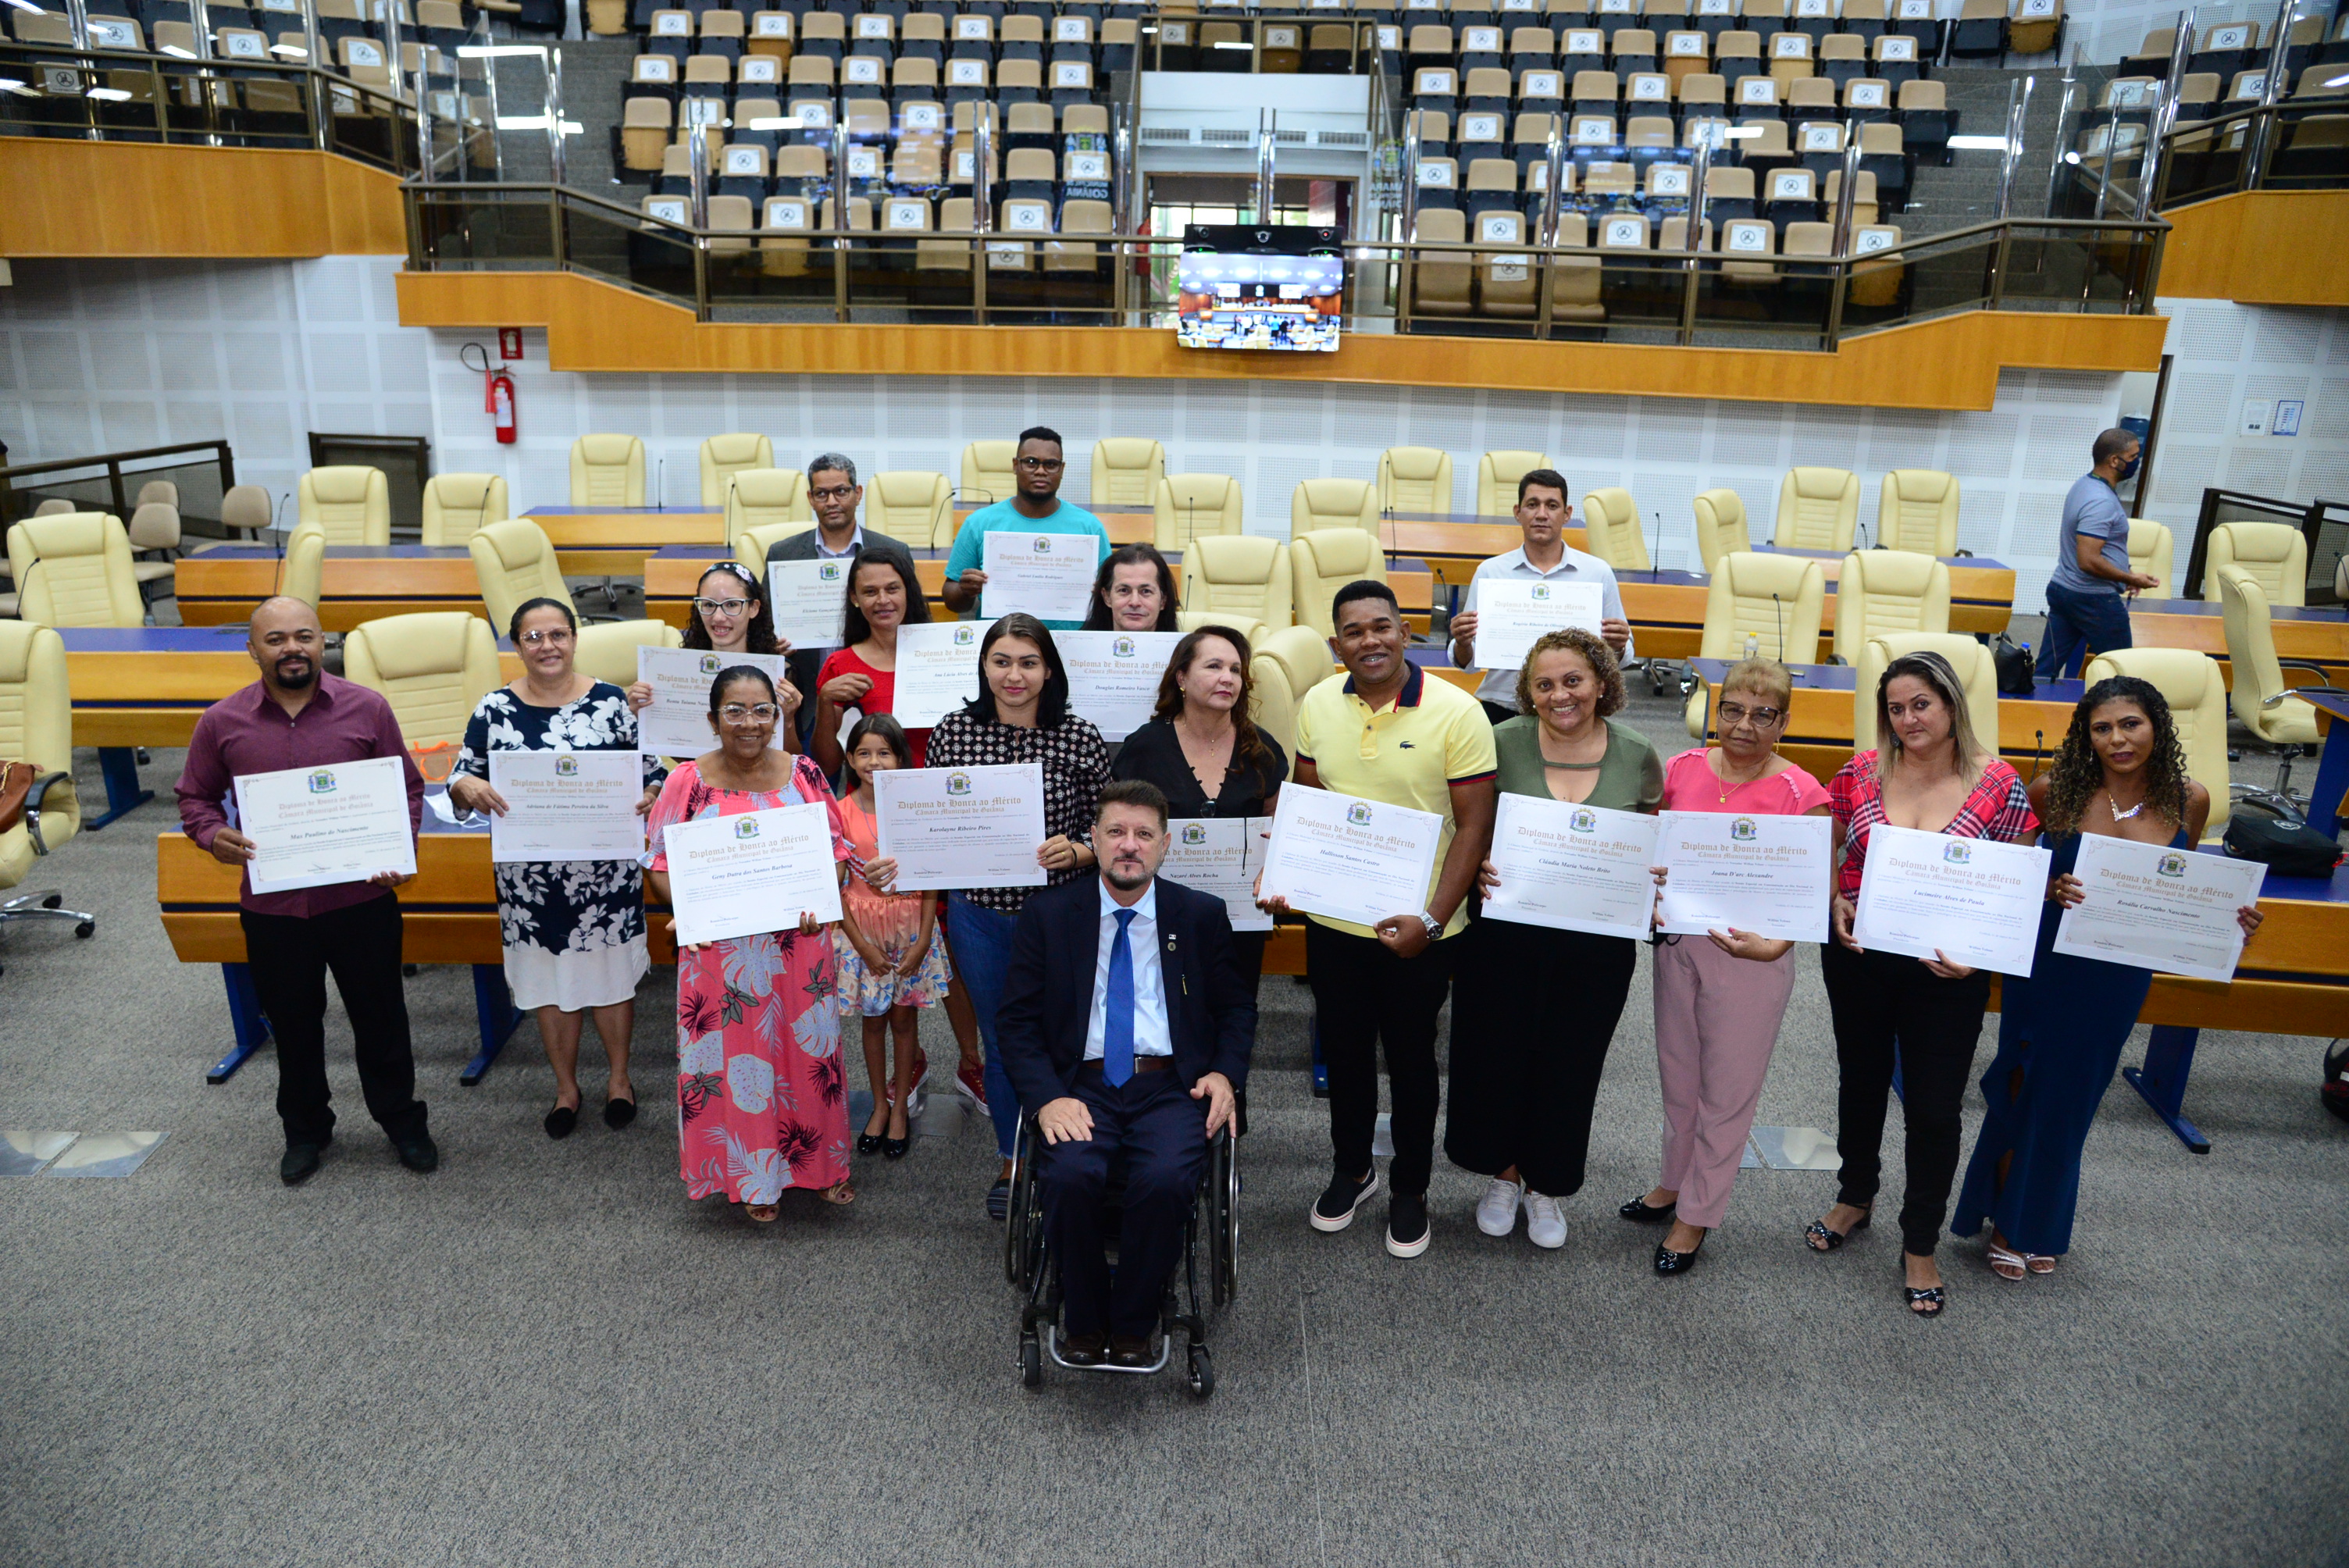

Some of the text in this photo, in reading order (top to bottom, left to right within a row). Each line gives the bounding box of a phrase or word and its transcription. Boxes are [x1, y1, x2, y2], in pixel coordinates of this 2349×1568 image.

[1114, 660, 1138, 668] Honra
[992, 796, 1021, 805] Mérito
[1297, 816, 1331, 830] Diploma
[1334, 824, 1342, 832] de
[1346, 826, 1372, 839] Honra
[1386, 836, 1415, 848] Mérito
[1311, 829, 1334, 838] Câmara
[1335, 834, 1364, 845] Municipal
[1374, 842, 1396, 852] Goiânia
[1518, 826, 1554, 839] Diploma
[1557, 832, 1566, 841] de
[1570, 834, 1596, 846] Honra
[1611, 841, 1641, 852] Mérito
[689, 848, 725, 858] Diploma
[739, 842, 765, 850] Honra
[781, 835, 808, 845] Mérito
[732, 850, 761, 859] Municipal
[1321, 849, 1344, 858] Hallisson
[1534, 838, 1557, 847] Câmara
[1559, 843, 1589, 852] Municipal
[1599, 849, 1623, 857] Goiânia
[1681, 841, 1717, 850] Diploma
[1733, 843, 1760, 853] Honra
[1777, 846, 1807, 855] Mérito
[1890, 857, 1927, 870] Diploma
[1930, 864, 1940, 872] de
[1944, 866, 1972, 878] Honra
[1988, 873, 2021, 885] Mérito
[1905, 869, 1930, 878] Câmara
[1932, 874, 1964, 884] Municipal
[1975, 880, 2001, 889] Goiânia
[2101, 868, 2139, 882] Diploma
[2142, 876, 2152, 885] de
[2155, 878, 2184, 890] Honra
[2201, 887, 2233, 899] Mérito
[2116, 881, 2141, 890] Câmara
[2143, 886, 2176, 896] Municipal
[2187, 893, 2212, 903] Goiânia
[2140, 903, 2165, 912] Carvalho
[2167, 909, 2200, 918] Nascimento
